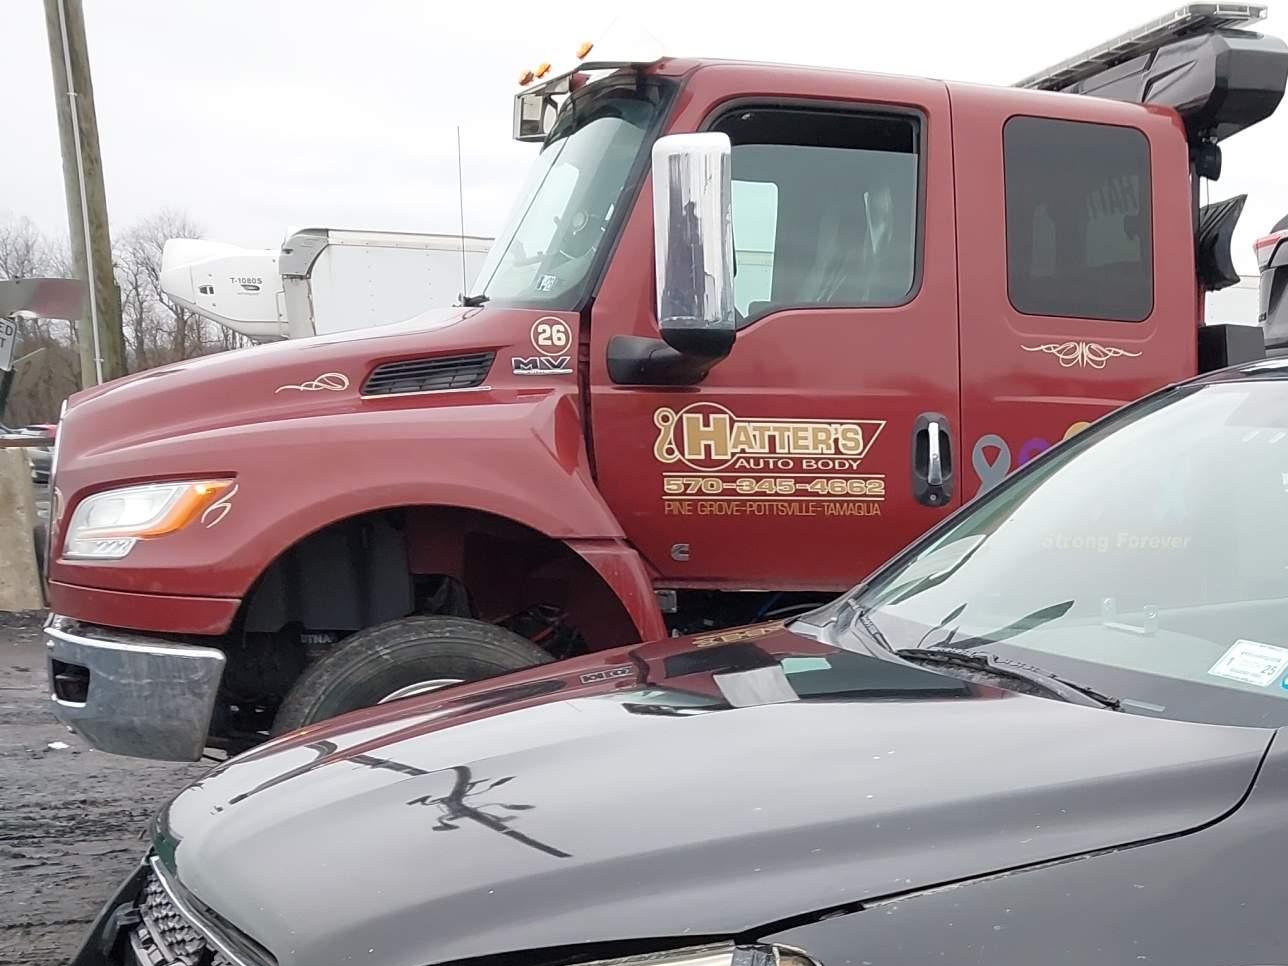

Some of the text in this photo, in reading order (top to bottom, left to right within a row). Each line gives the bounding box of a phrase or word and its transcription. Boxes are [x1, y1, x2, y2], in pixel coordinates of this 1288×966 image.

[537, 323, 567, 346] 26
[511, 356, 571, 370] MV
[682, 413, 864, 460] HATTER'S
[734, 458, 863, 471] AUTO BODY
[663, 477, 886, 495] 570-345-4662
[664, 501, 881, 516] PINE GROVE-POTTSVILLE-TAMAQUA
[1041, 531, 1192, 552] Strong Forever
